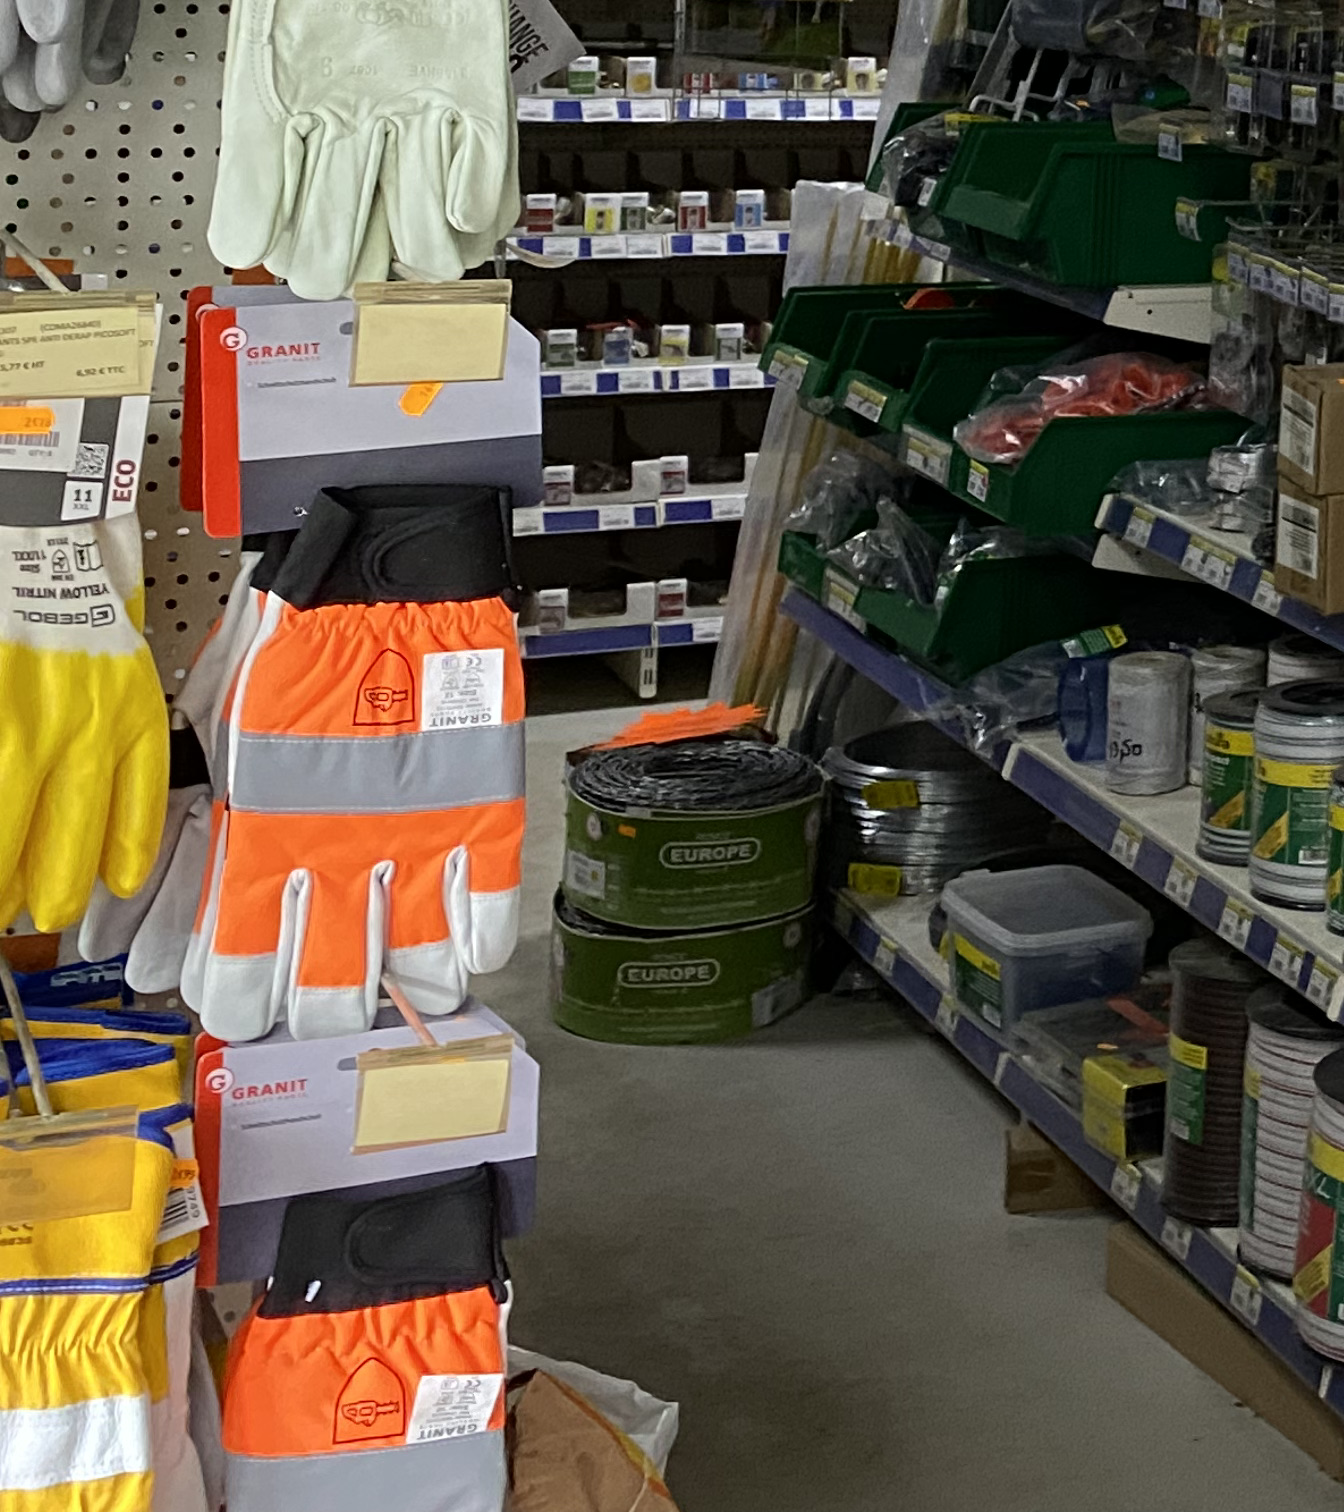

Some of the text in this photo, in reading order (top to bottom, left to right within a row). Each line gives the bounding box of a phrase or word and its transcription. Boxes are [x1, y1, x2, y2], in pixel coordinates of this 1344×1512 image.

[63, 332, 92, 342] DERAP
[246, 342, 321, 359] GRANIT
[108, 366, 126, 374] TTC
[112, 460, 136, 502] ECO
[74, 489, 92, 502] 11
[73, 503, 90, 511] XXL
[60, 583, 110, 599] YELLOW
[13, 609, 88, 625] GEBOL
[430, 712, 492, 727] GRANIT
[670, 843, 751, 863] EUROPE
[627, 964, 711, 983] EUROPE
[232, 1078, 308, 1100] GRANIT
[417, 1423, 478, 1440] GRANIT
